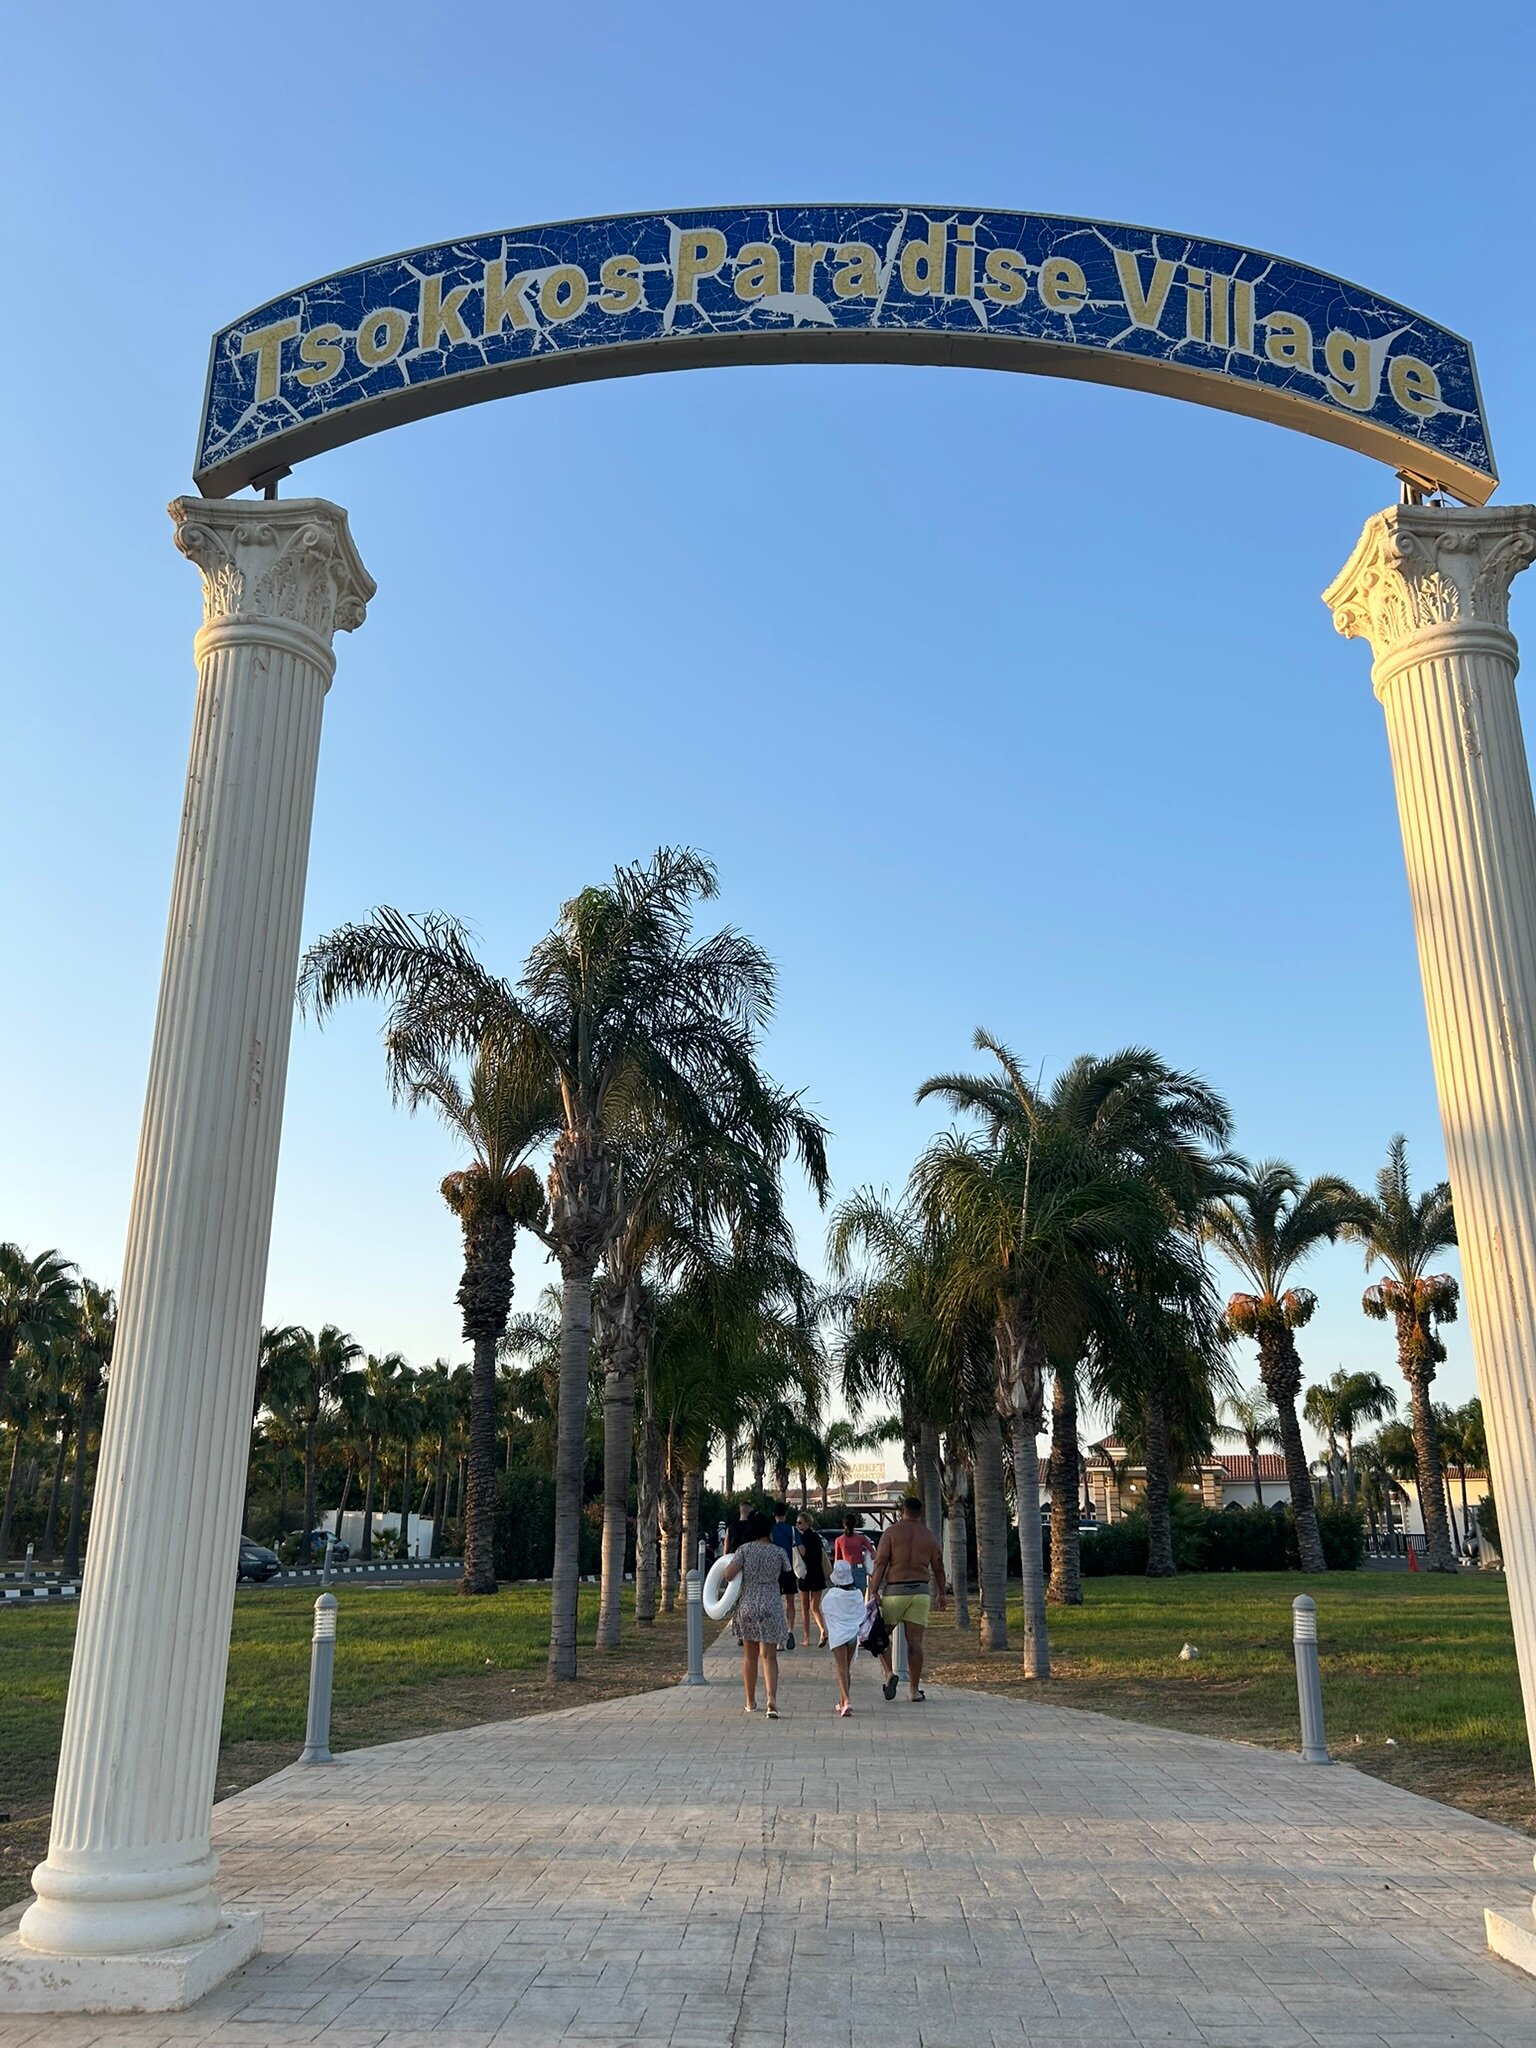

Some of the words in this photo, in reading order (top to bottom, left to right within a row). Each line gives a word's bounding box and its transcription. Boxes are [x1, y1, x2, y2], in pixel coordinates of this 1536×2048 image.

[240, 252, 645, 404] Tsokkos
[676, 222, 1087, 312] Paradise
[1115, 248, 1443, 416] Village
